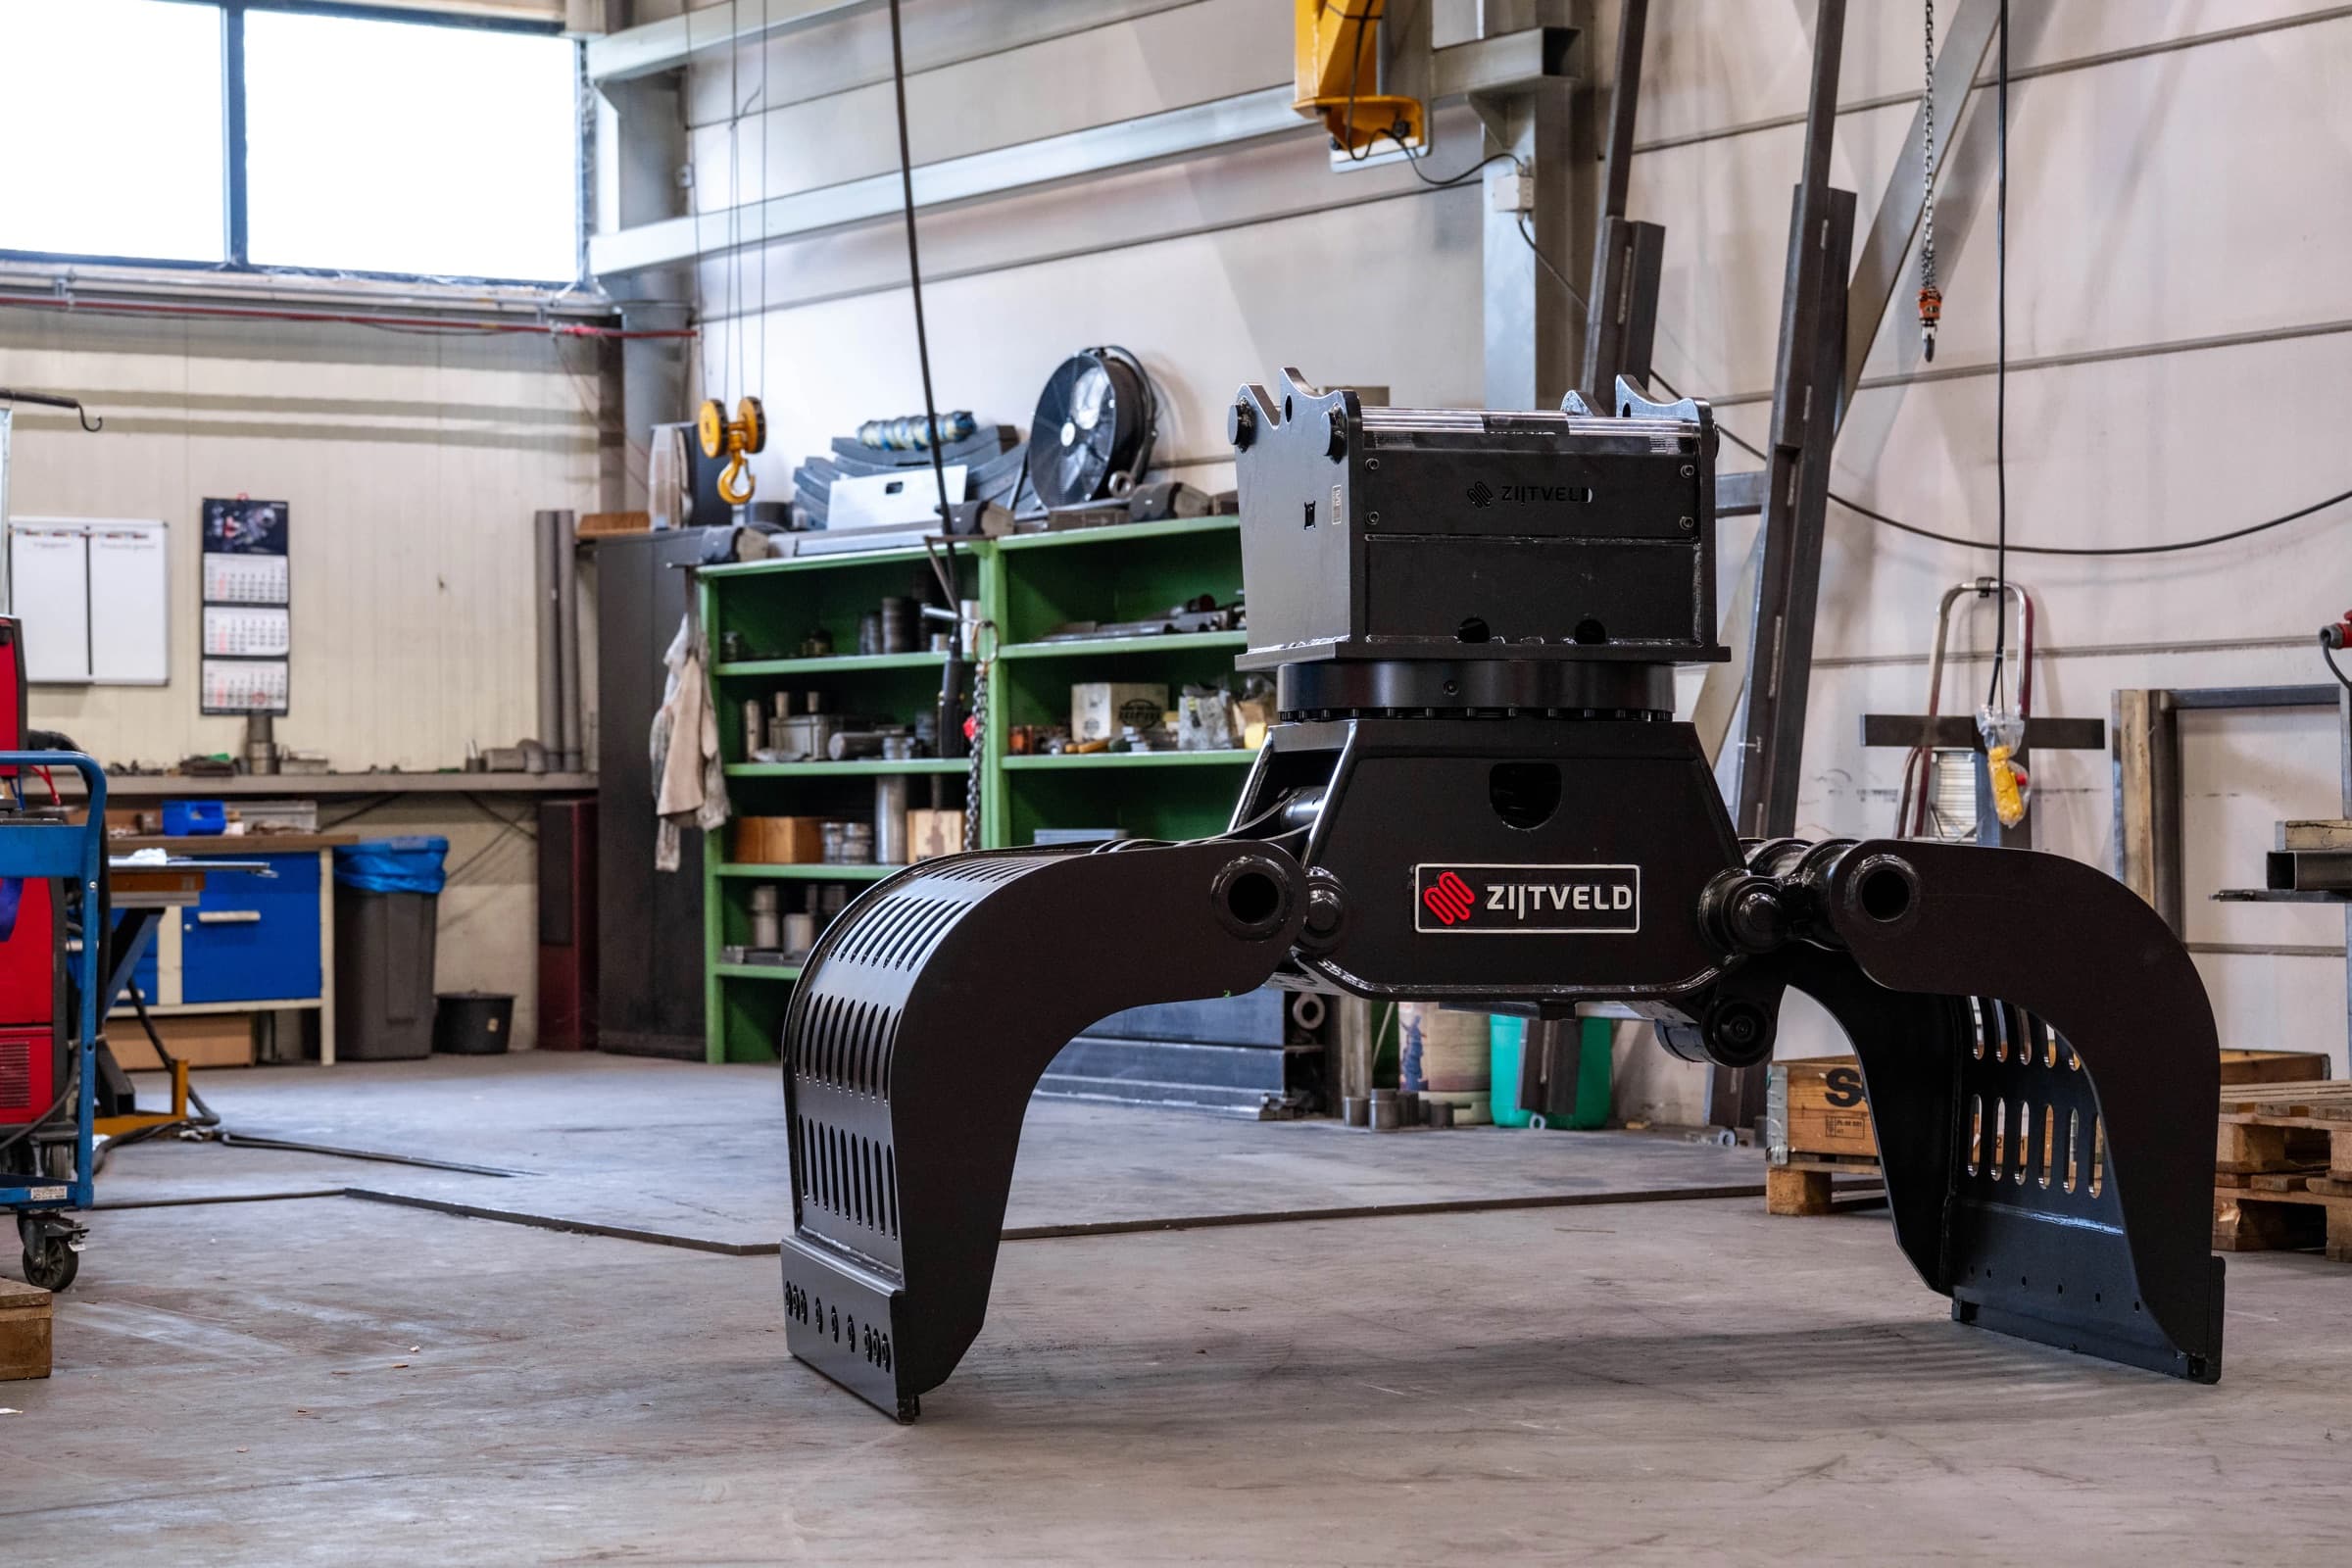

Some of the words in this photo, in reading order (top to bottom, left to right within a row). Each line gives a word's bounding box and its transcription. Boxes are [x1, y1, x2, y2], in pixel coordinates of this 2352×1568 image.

[1501, 485, 1593, 507] ZIJTVELD
[1486, 884, 1633, 920] ZIJTVELD
[1825, 1067, 1866, 1107] S
